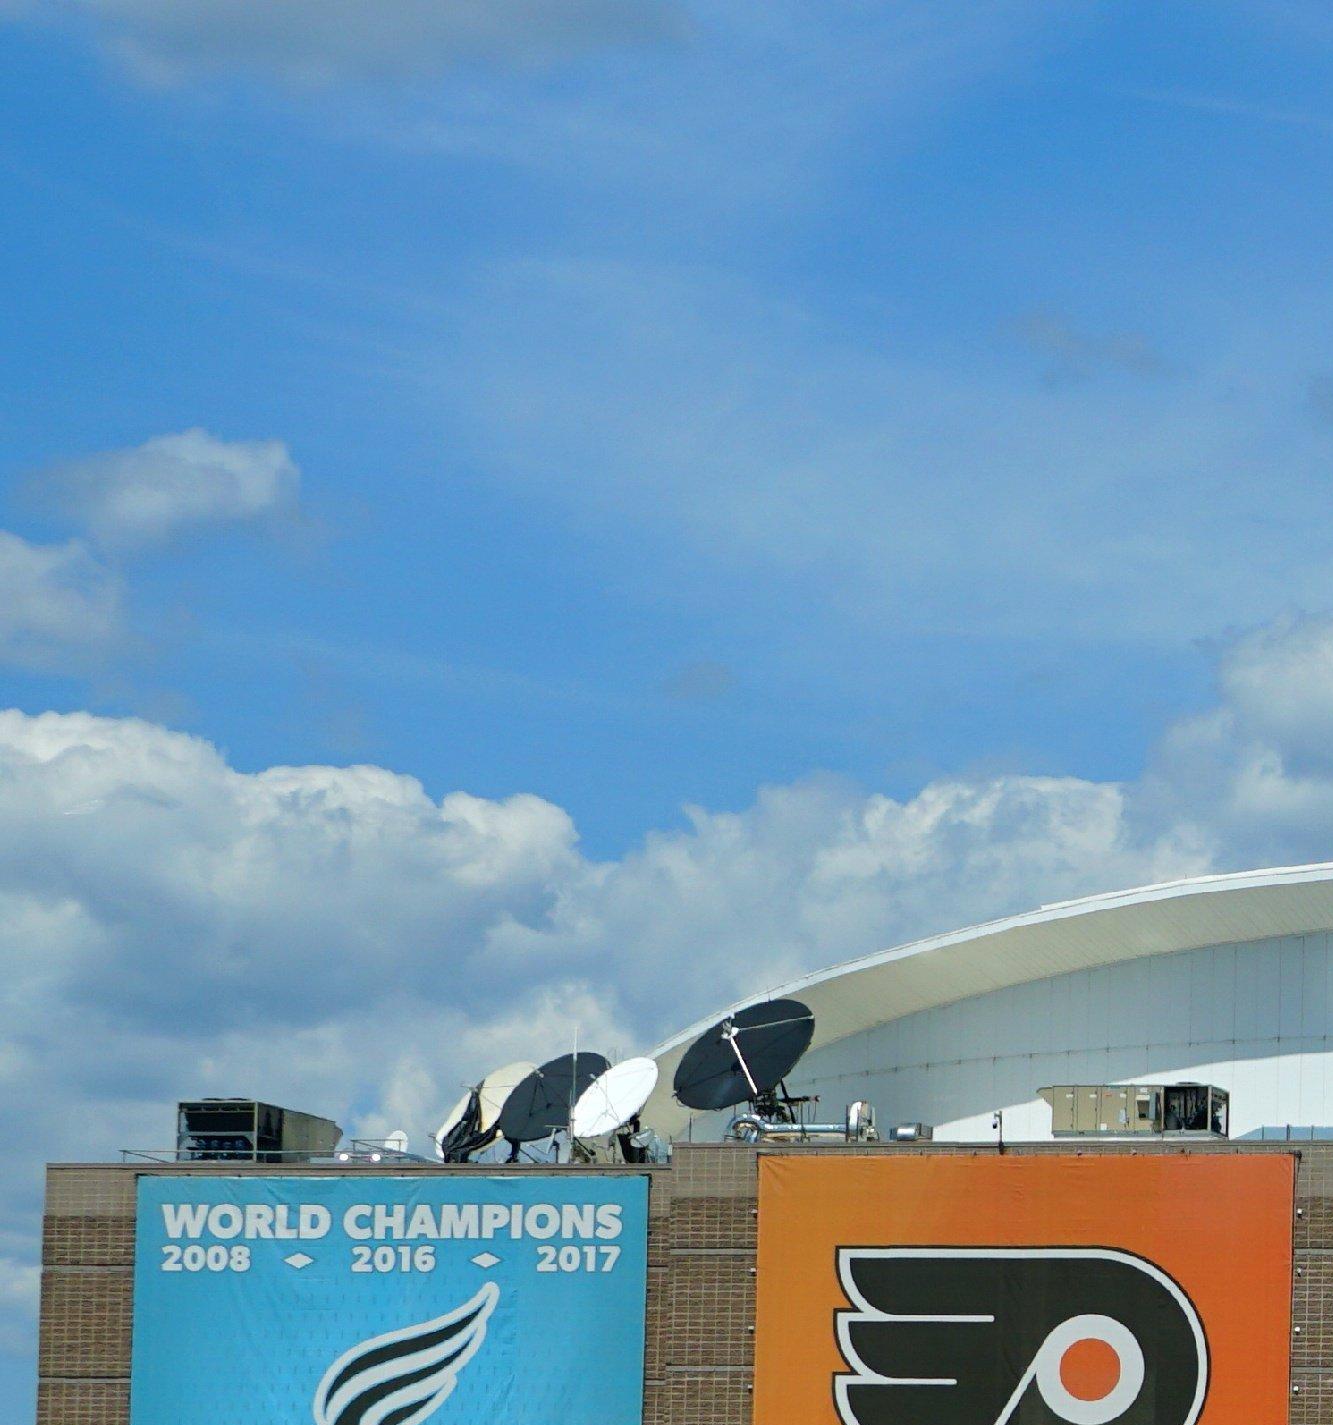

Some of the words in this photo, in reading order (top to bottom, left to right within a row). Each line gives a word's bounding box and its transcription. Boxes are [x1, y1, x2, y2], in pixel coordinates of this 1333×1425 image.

[161, 1203, 331, 1239] WORLD
[343, 1203, 623, 1239] CHAMPIONS
[161, 1245, 252, 1272] 2008
[351, 1245, 437, 1272] 2016
[536, 1245, 621, 1272] 2017
